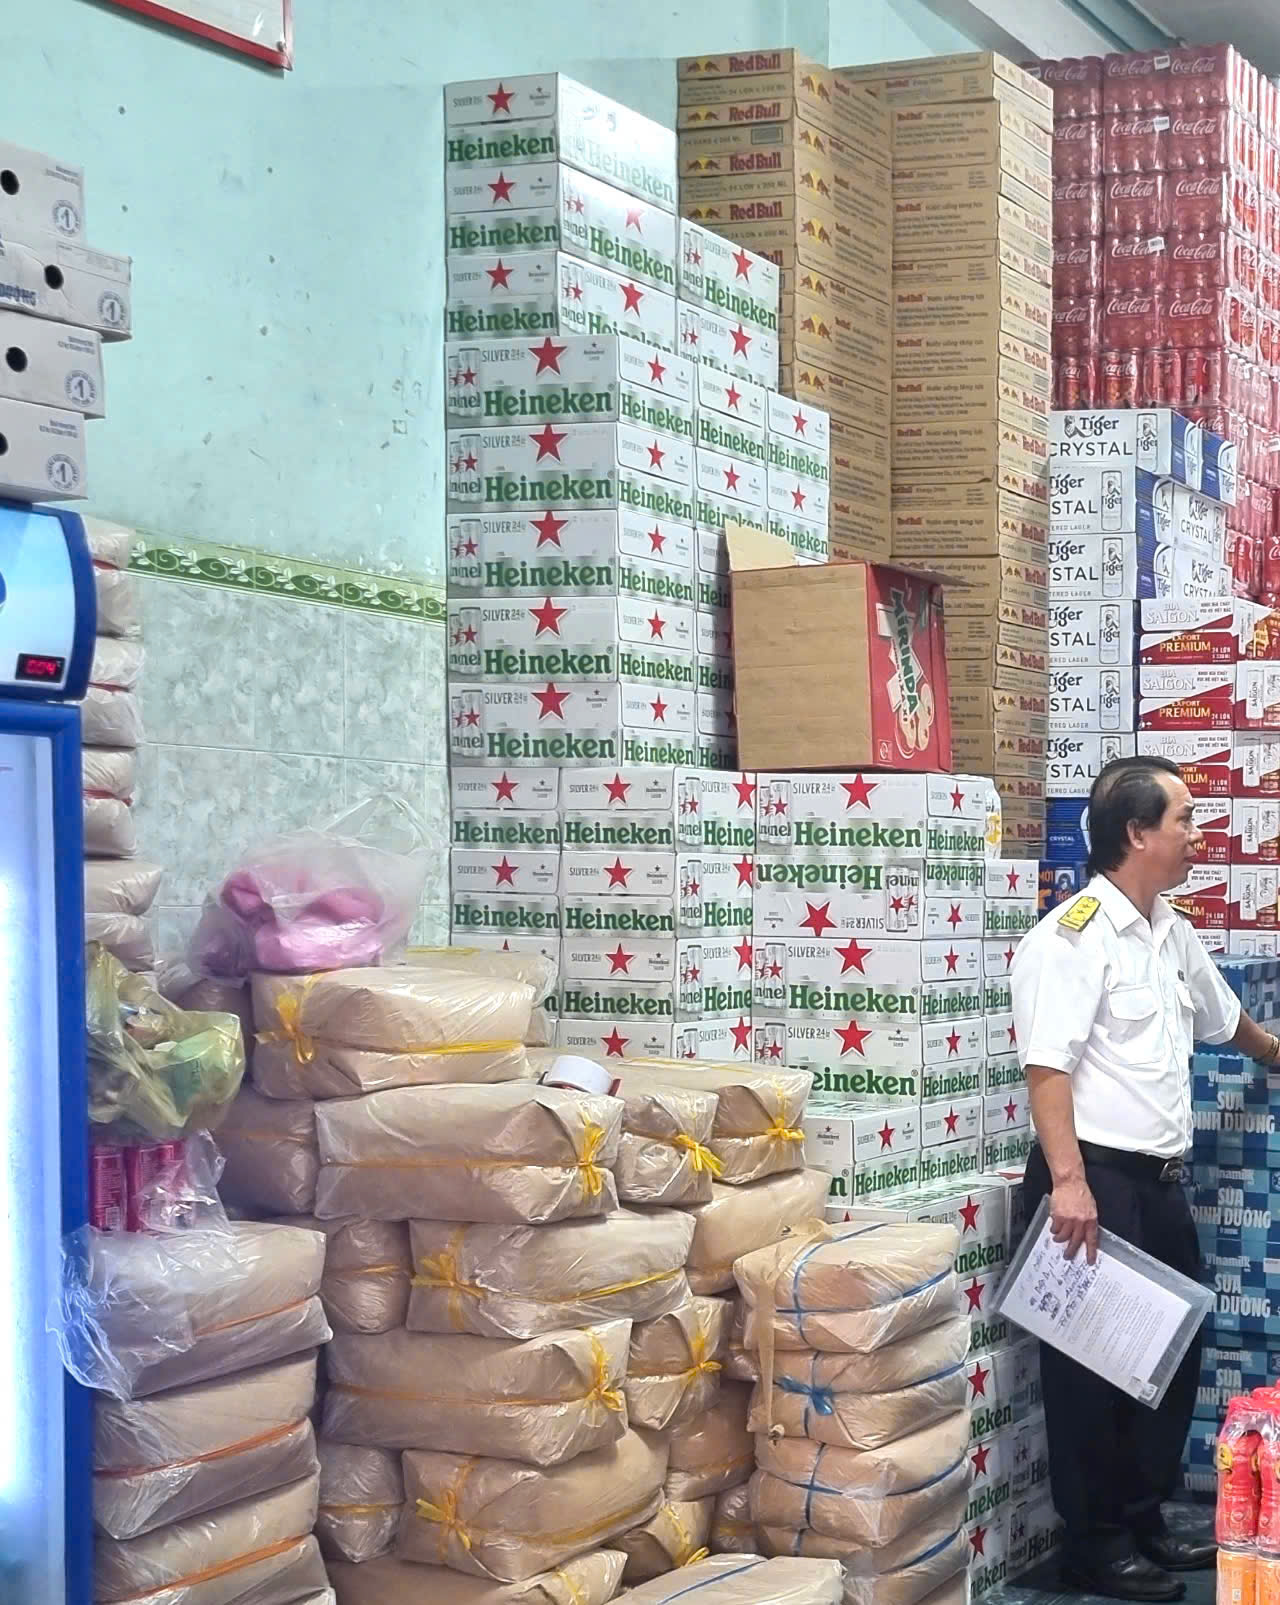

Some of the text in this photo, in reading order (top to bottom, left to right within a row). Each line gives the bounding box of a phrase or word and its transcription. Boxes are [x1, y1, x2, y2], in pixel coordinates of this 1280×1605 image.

[728, 54, 781, 73] Red Bull
[729, 102, 781, 121] Red Bull
[729, 151, 782, 170] Red Bull
[729, 201, 782, 220] Red Bull
[484, 389, 612, 416] Heineken
[621, 393, 693, 435] Heineken
[1080, 416, 1119, 436] Tiger
[1050, 442, 1133, 456] CRYSTAL
[485, 476, 613, 502] Heineken
[619, 479, 692, 519] Heineken
[483, 521, 511, 533] SILVER
[1181, 520, 1212, 544] CRYSTAL
[485, 562, 613, 588] Heineken
[620, 566, 693, 601] Heineken
[482, 608, 511, 621] SILVER
[1160, 642, 1210, 652] PREMIUM
[484, 649, 612, 676] Heineken
[620, 654, 692, 681] Heineken
[1159, 708, 1210, 718] PREMIUM
[487, 732, 616, 758] Heineken
[624, 740, 694, 766] Heineken
[792, 783, 820, 794] SILVER
[454, 820, 560, 844] Heineken
[565, 822, 672, 845] Heineken
[794, 822, 922, 848] Heineken
[928, 830, 984, 850] Heineken
[757, 864, 883, 890] Heineken
[455, 904, 560, 929] Heineken
[566, 908, 674, 931] Heineken
[856, 918, 884, 929] SILVER
[788, 946, 816, 958] SILVER
[565, 991, 672, 1016] Heineken
[789, 984, 916, 1013] Heineken
[922, 994, 980, 1015] Heineken
[788, 1026, 816, 1038] SILVER
[811, 1067, 917, 1096] eineken
